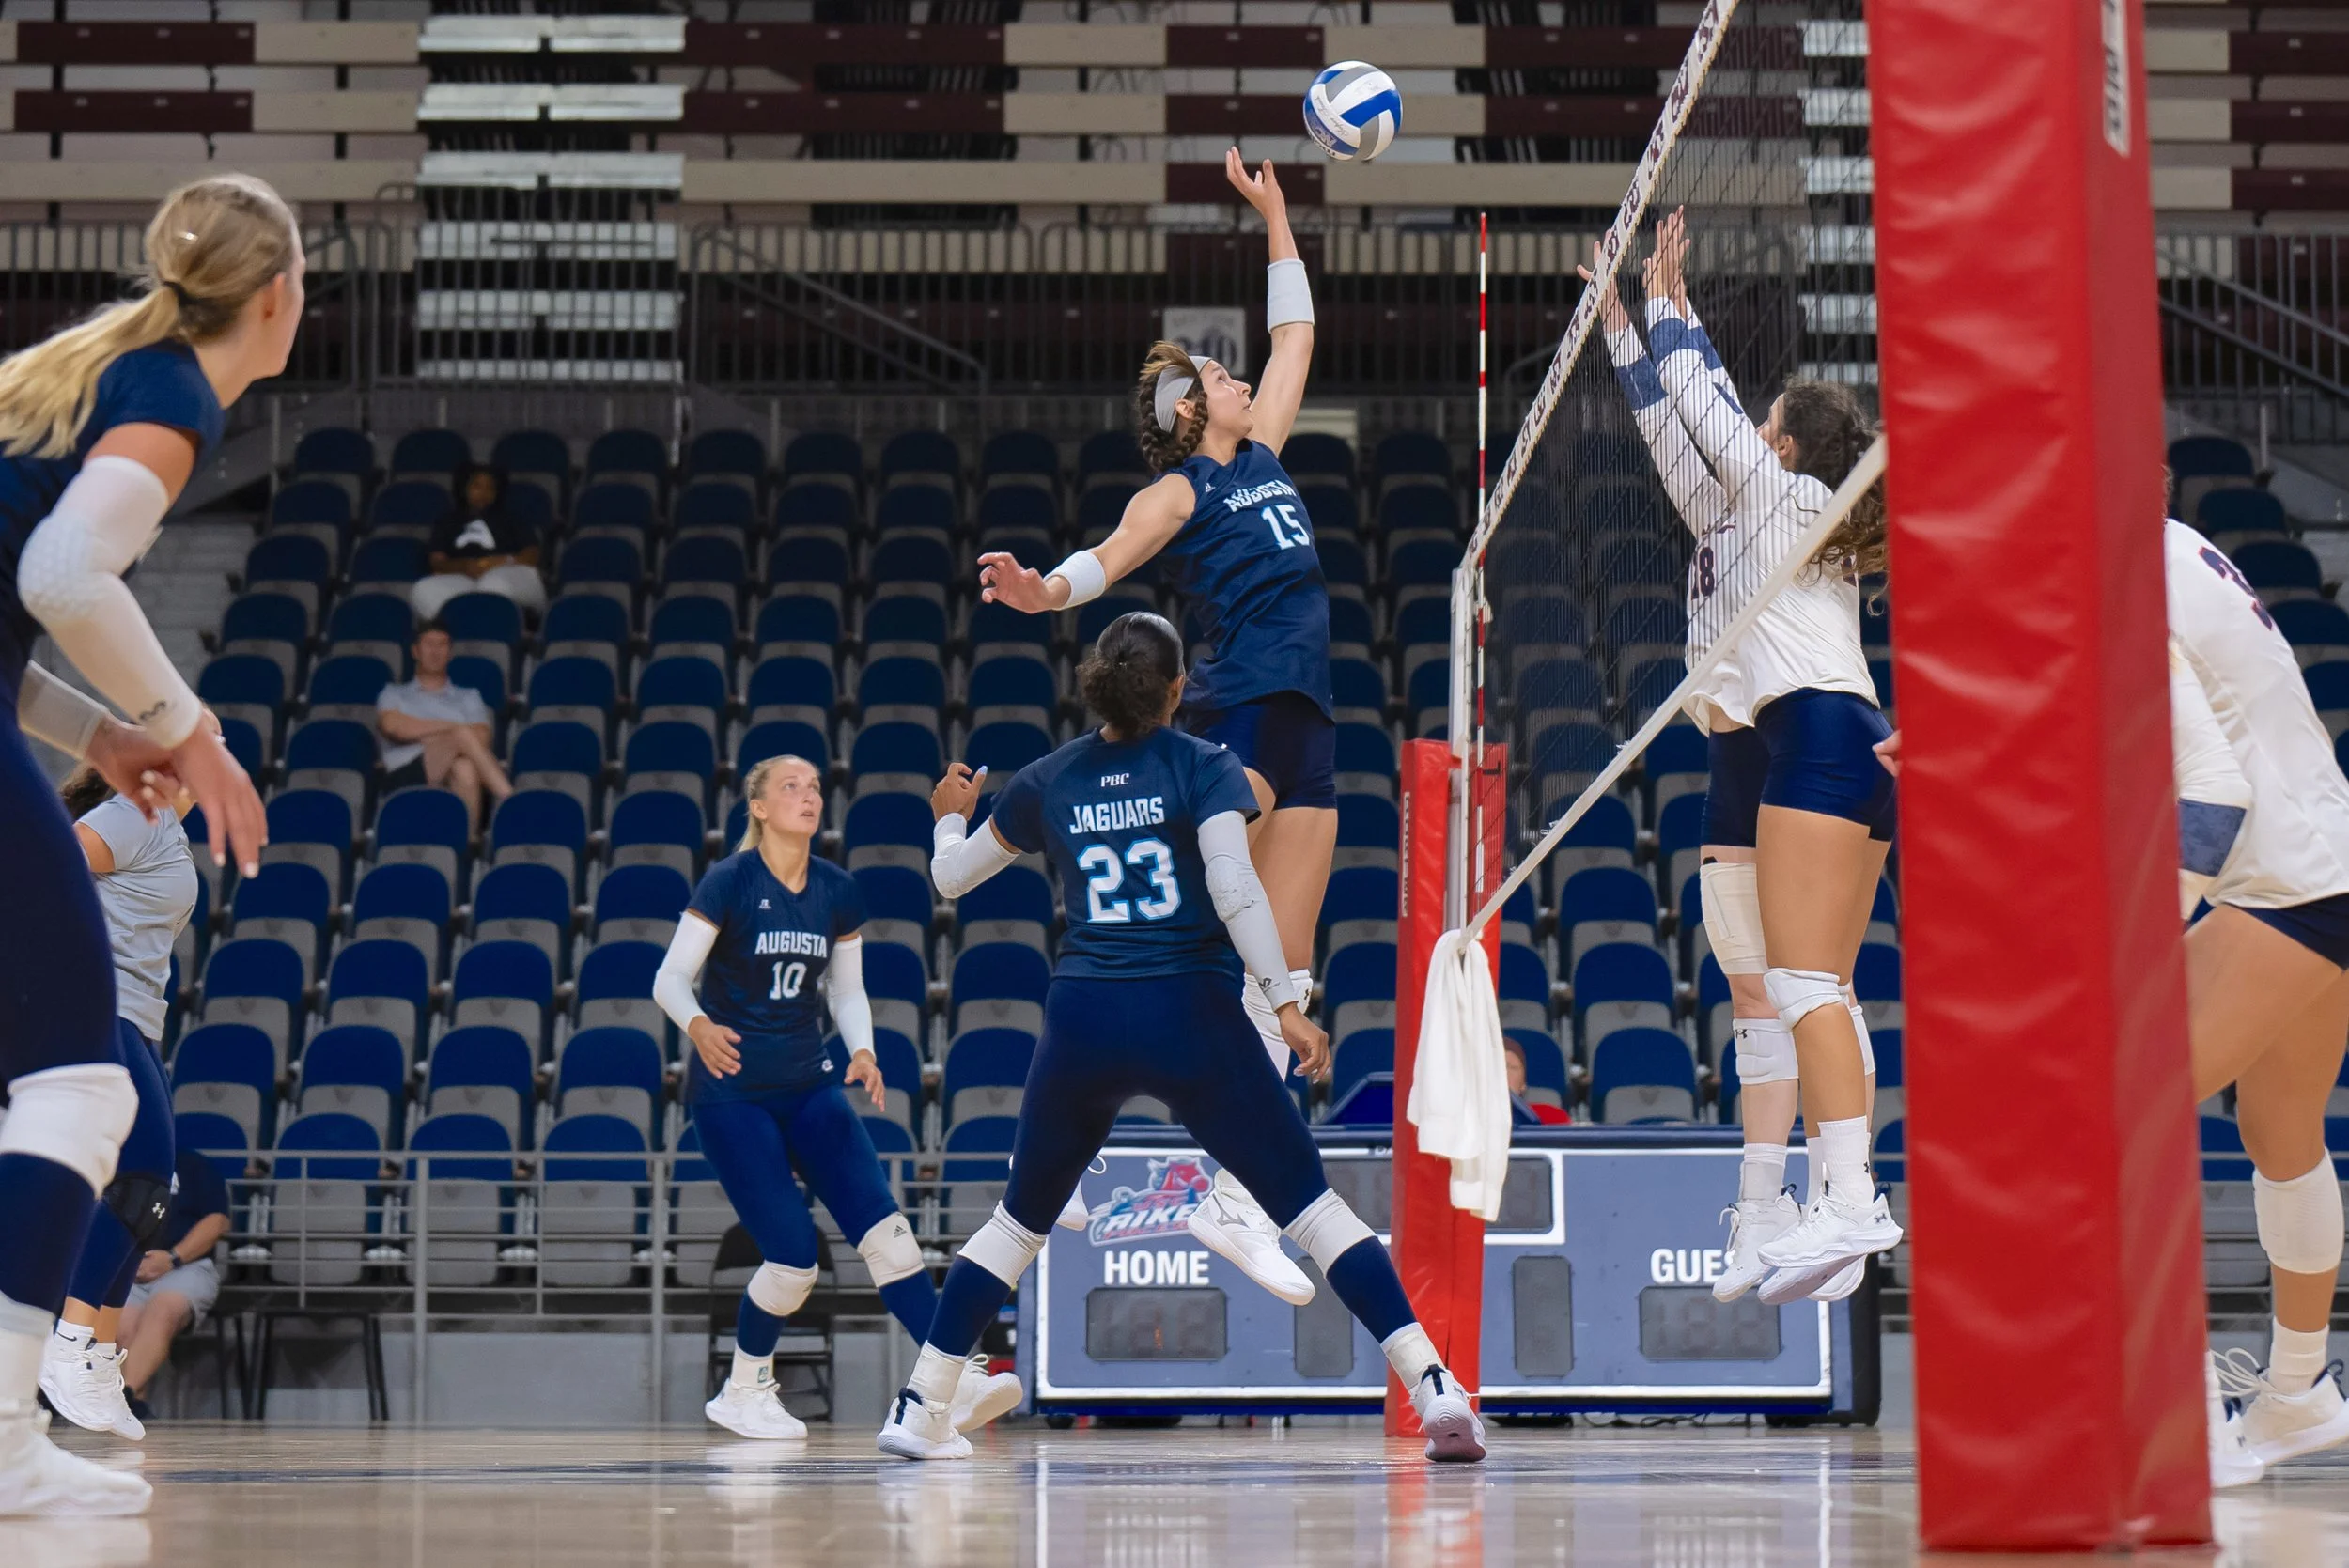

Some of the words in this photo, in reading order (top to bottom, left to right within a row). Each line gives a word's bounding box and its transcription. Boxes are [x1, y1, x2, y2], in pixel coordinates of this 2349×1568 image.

[1223, 479, 1297, 513] AUGUSTA
[1261, 503, 1310, 551] 15
[1100, 772, 1130, 788] PBC
[1069, 796, 1165, 835] JAGUARS
[1077, 836, 1182, 924] 23
[754, 931, 827, 958] AUGUSTA
[769, 960, 807, 1001] 10
[1103, 1203, 1201, 1233] AIKE
[1104, 1250, 1210, 1285] HOME
[1651, 1249, 1736, 1283] GUE
